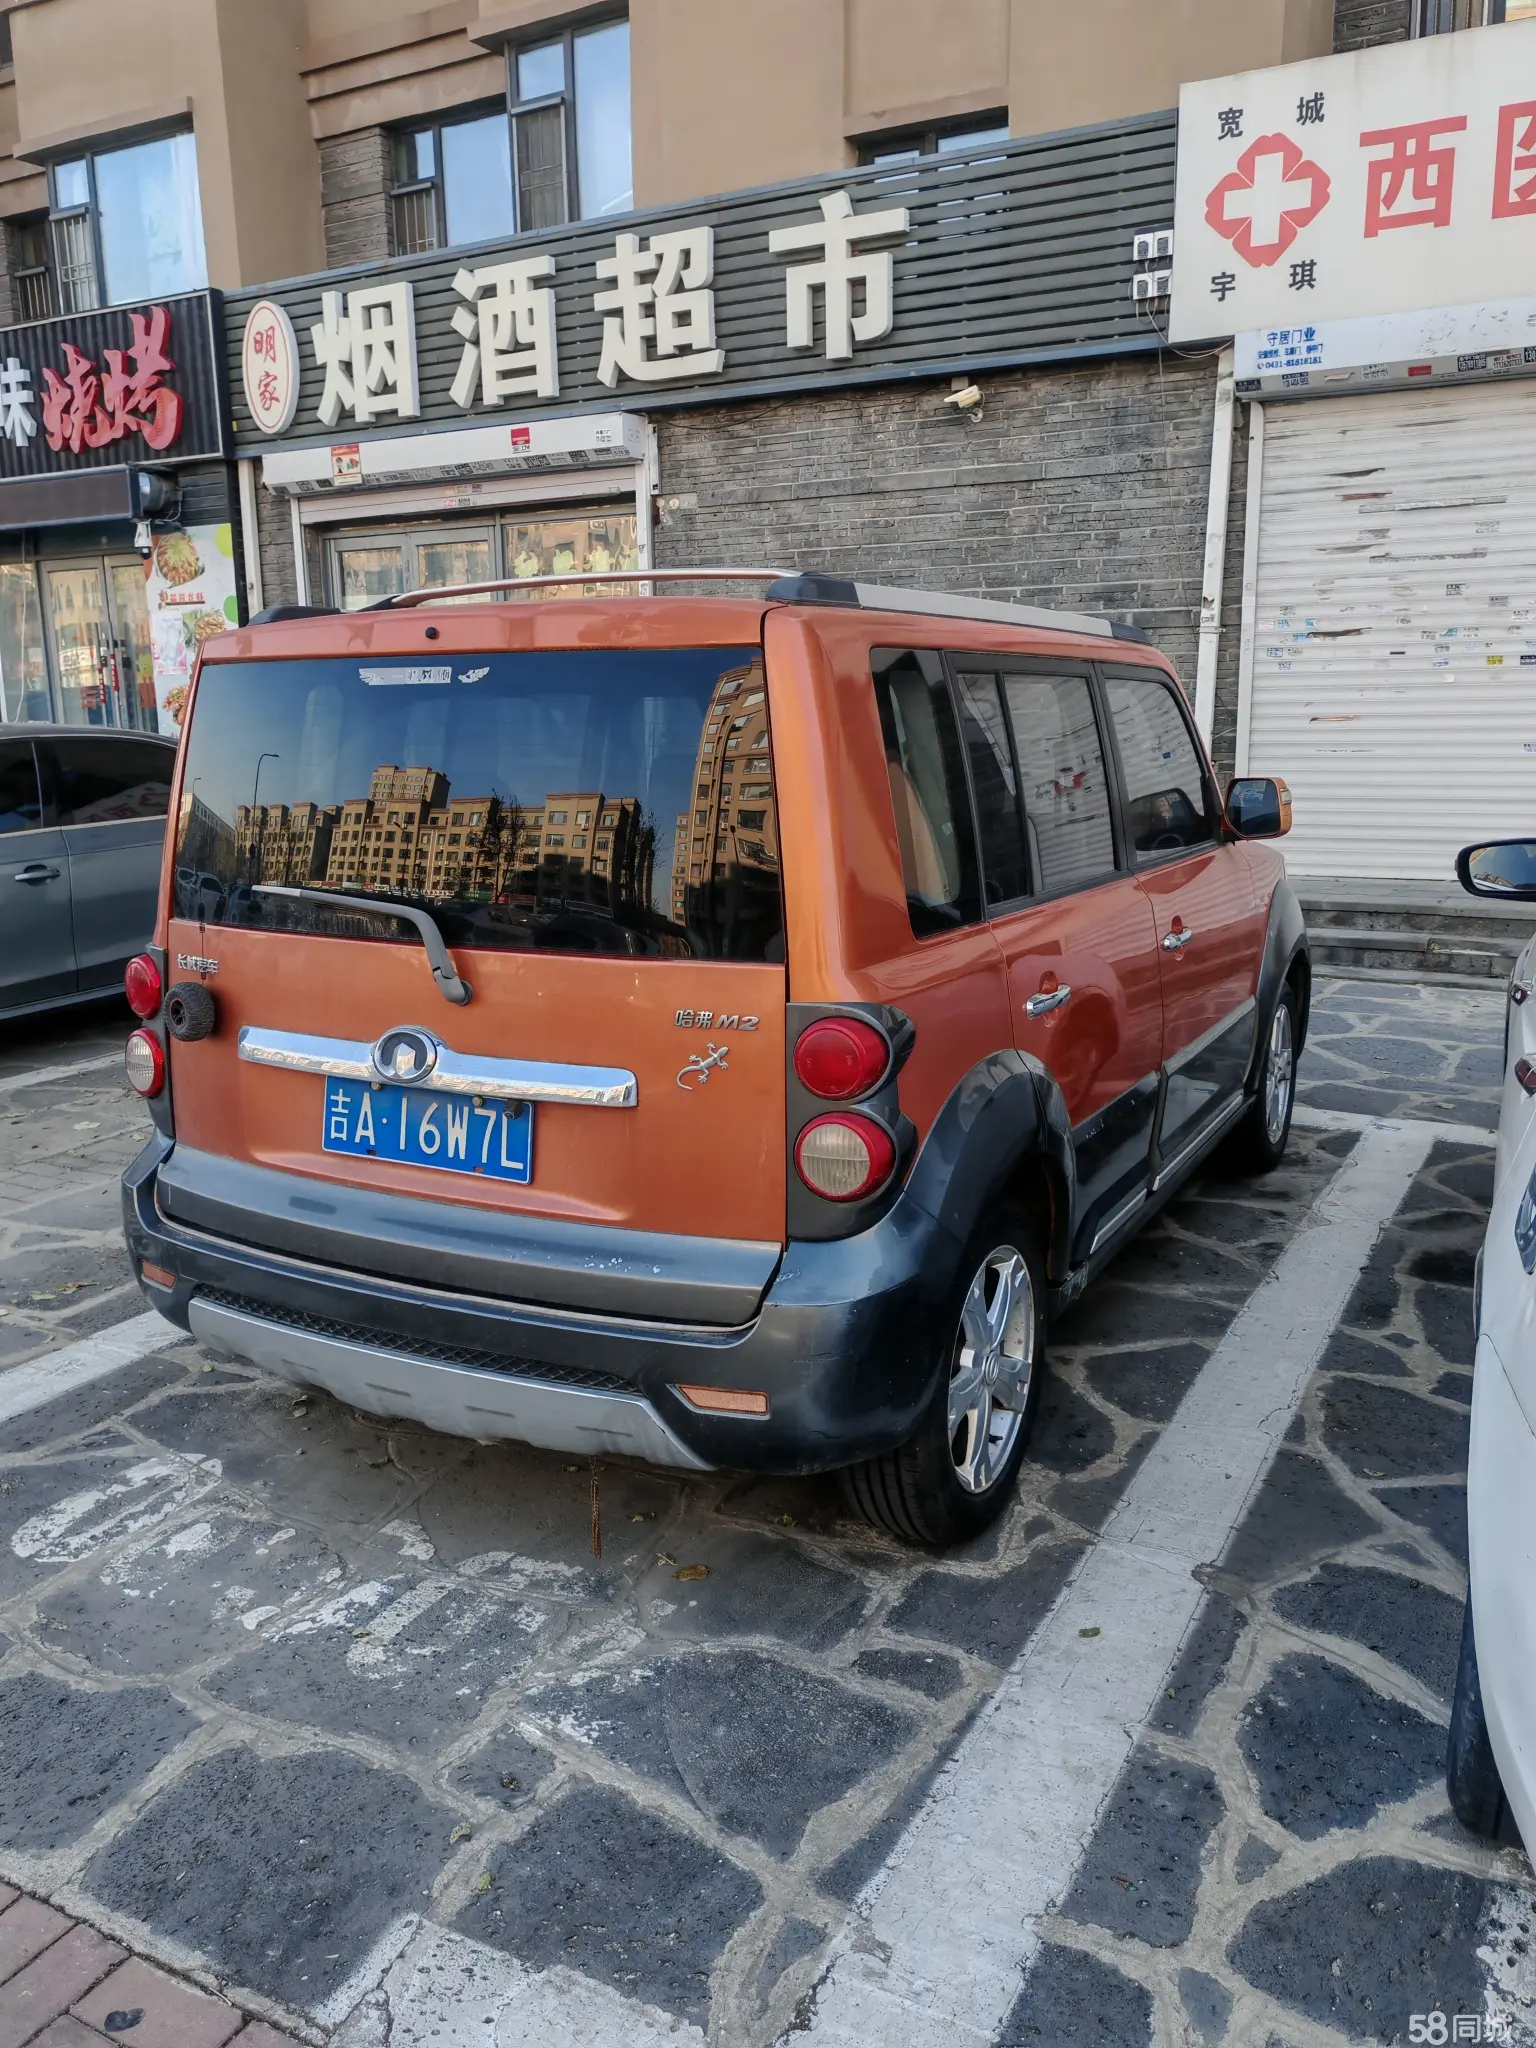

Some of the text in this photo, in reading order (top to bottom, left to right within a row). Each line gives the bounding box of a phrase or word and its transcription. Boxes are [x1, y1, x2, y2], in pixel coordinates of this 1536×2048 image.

[311, 190, 911, 426] 烟酒超市
[1267, 327, 1316, 346] 守居门业
[253, 325, 280, 411] 明家
[177, 953, 219, 975] 长城汽车
[675, 1009, 759, 1031] 哈弗 M2
[329, 1087, 525, 1171] 吉A·16W7L
